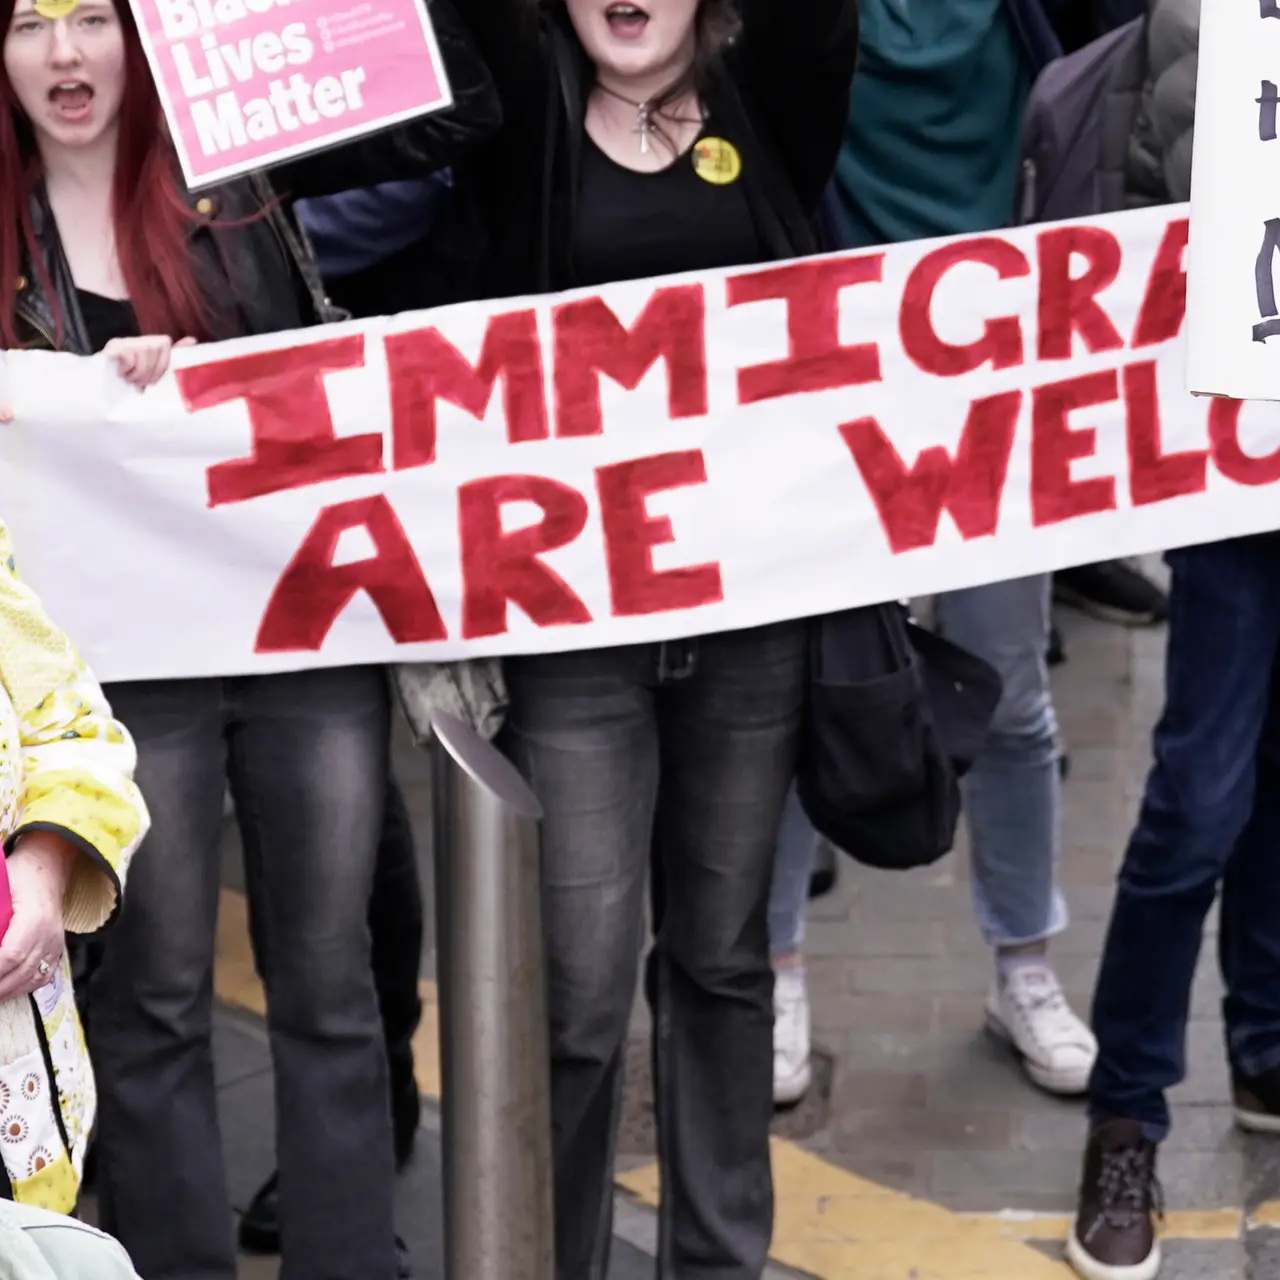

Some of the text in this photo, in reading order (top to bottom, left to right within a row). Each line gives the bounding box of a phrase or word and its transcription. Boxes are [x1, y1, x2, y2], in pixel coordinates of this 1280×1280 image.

[170, 21, 314, 98] Lives
[189, 66, 366, 157] Matter
[253, 449, 723, 653] ARE
